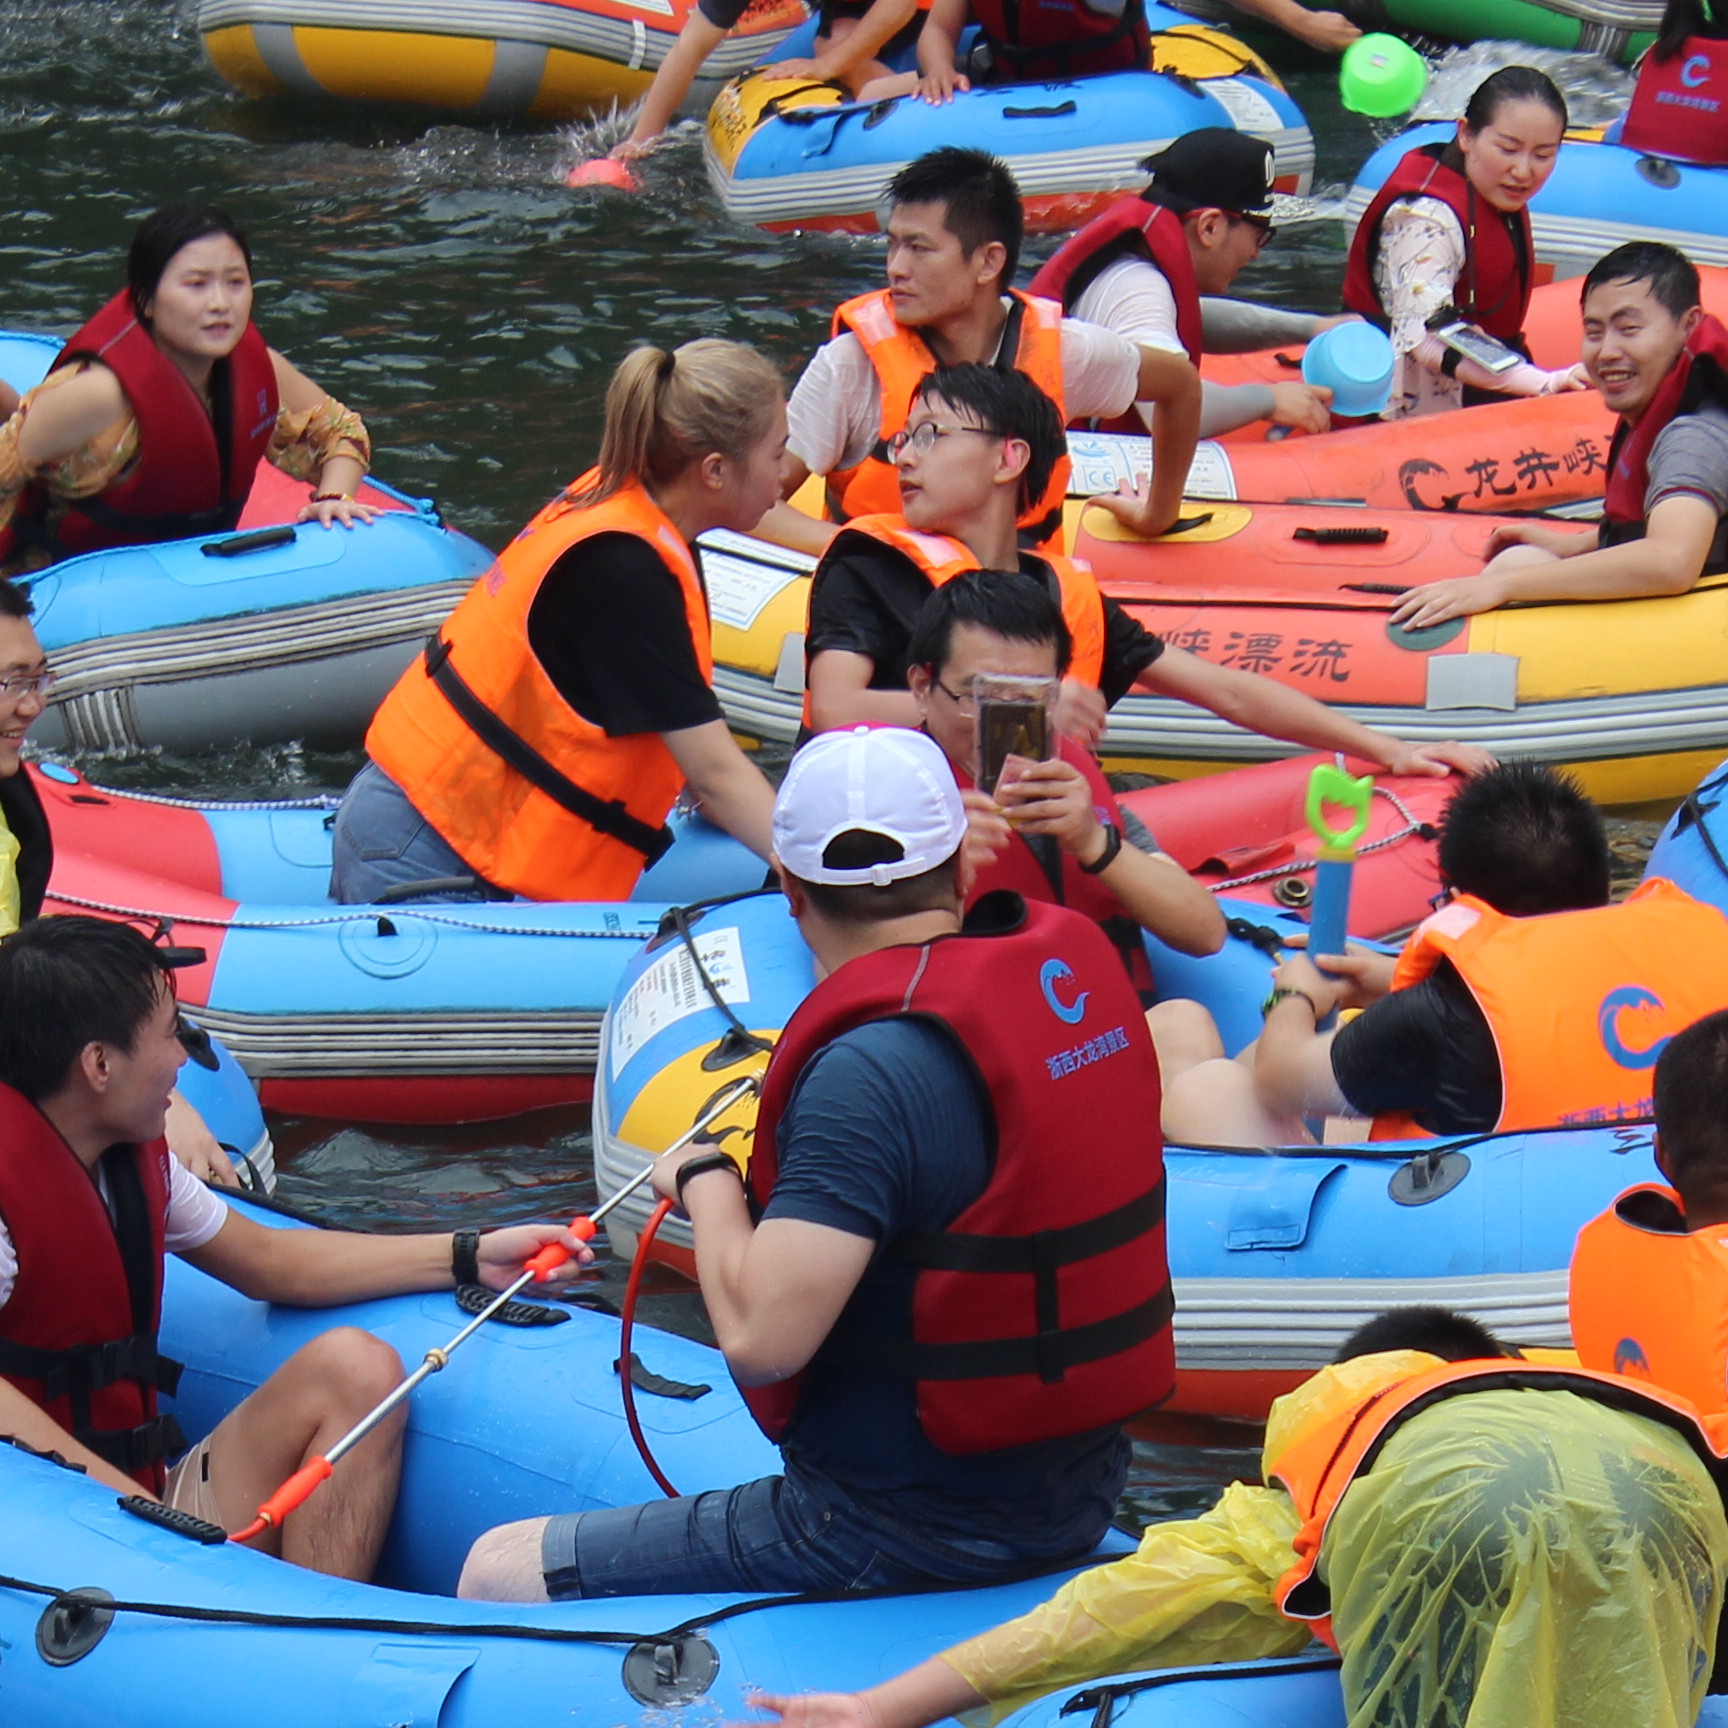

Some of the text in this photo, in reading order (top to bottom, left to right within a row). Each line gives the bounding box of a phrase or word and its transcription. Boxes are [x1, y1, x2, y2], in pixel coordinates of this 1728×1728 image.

[1465, 435, 1614, 498] 龙井峡
[1045, 1025, 1130, 1081] 浙西大龙湾景区
